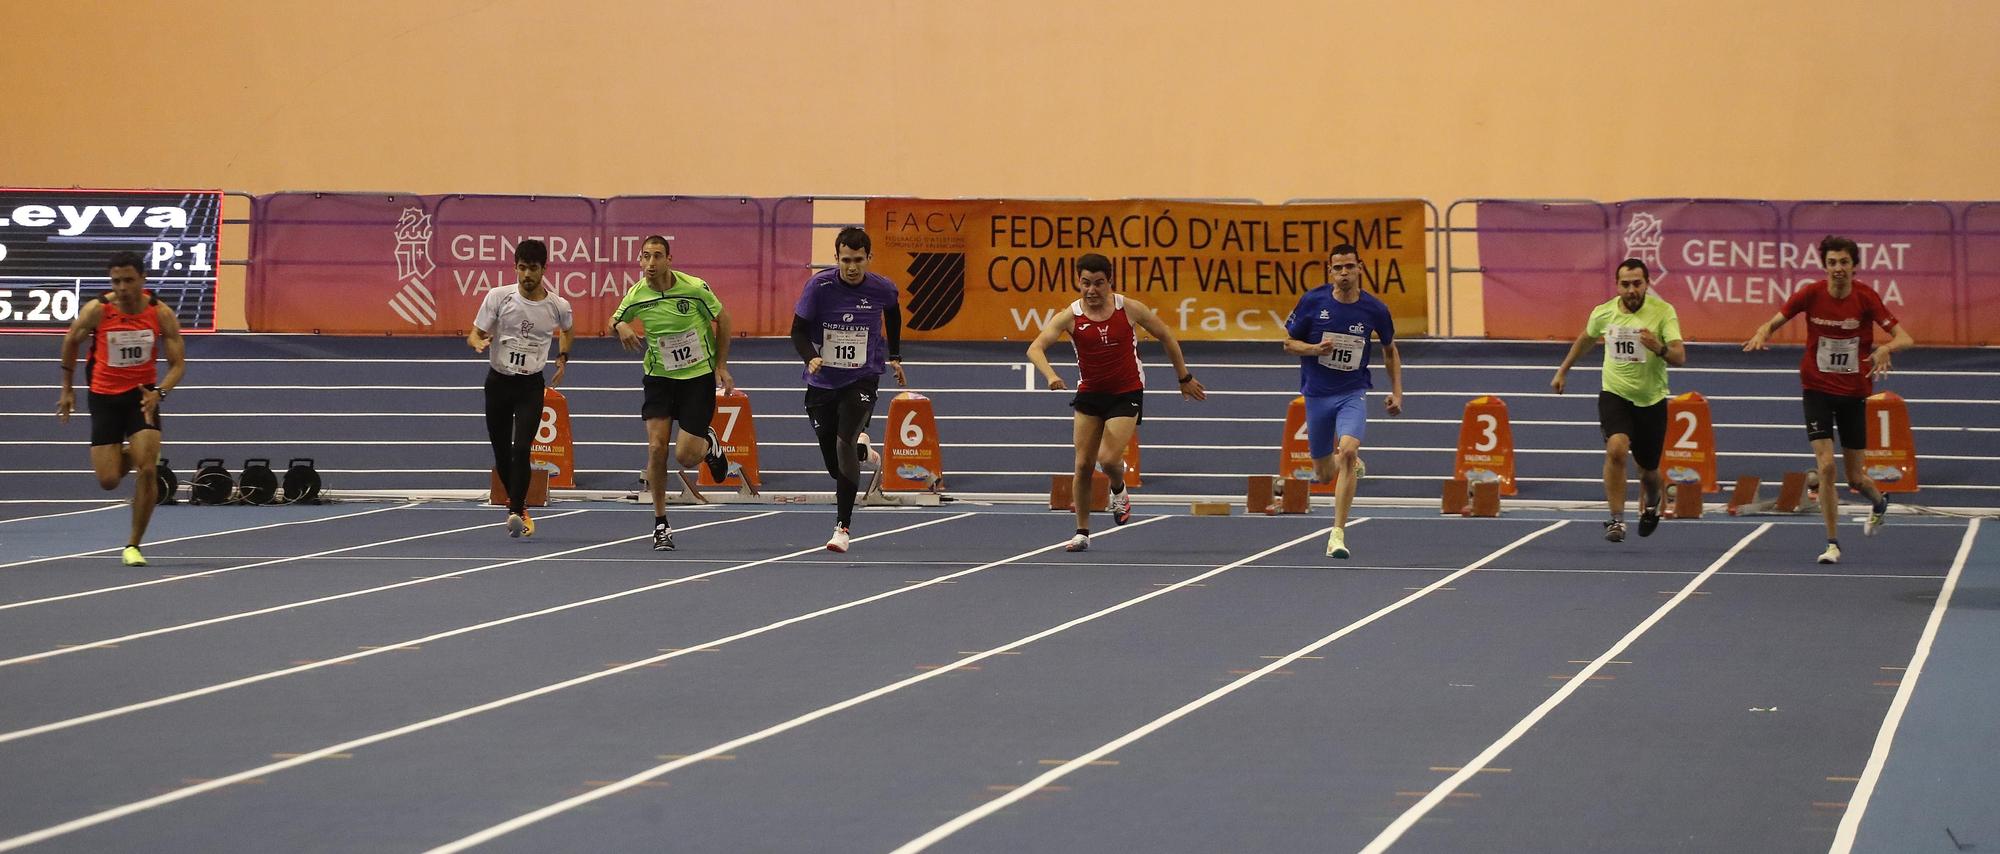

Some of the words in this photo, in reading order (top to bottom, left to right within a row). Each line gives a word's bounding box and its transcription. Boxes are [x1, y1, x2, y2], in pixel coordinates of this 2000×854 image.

[885, 211, 967, 233] FACV
[990, 209, 1179, 250] FEDERACIÓ
[1188, 216, 1403, 253] D'ATLETISME
[151, 241, 212, 271] P:1
[450, 234, 675, 264] GENRALIT
[1682, 238, 1911, 271] GENERATAT
[1193, 256, 1406, 296] VALENCINA
[1685, 275, 1905, 306] VALENA
[120, 346, 142, 360] 110
[509, 351, 527, 367] 111
[671, 346, 692, 362] 112
[834, 345, 856, 360] 113
[1331, 348, 1353, 363] 115
[1614, 341, 1635, 355] 116
[1829, 352, 1849, 366] 117
[534, 406, 558, 444] 8
[717, 406, 742, 443] 7
[900, 410, 924, 447] 6
[1475, 414, 1498, 452] 3
[1673, 411, 1698, 449] 2
[1877, 410, 1890, 448] 1
